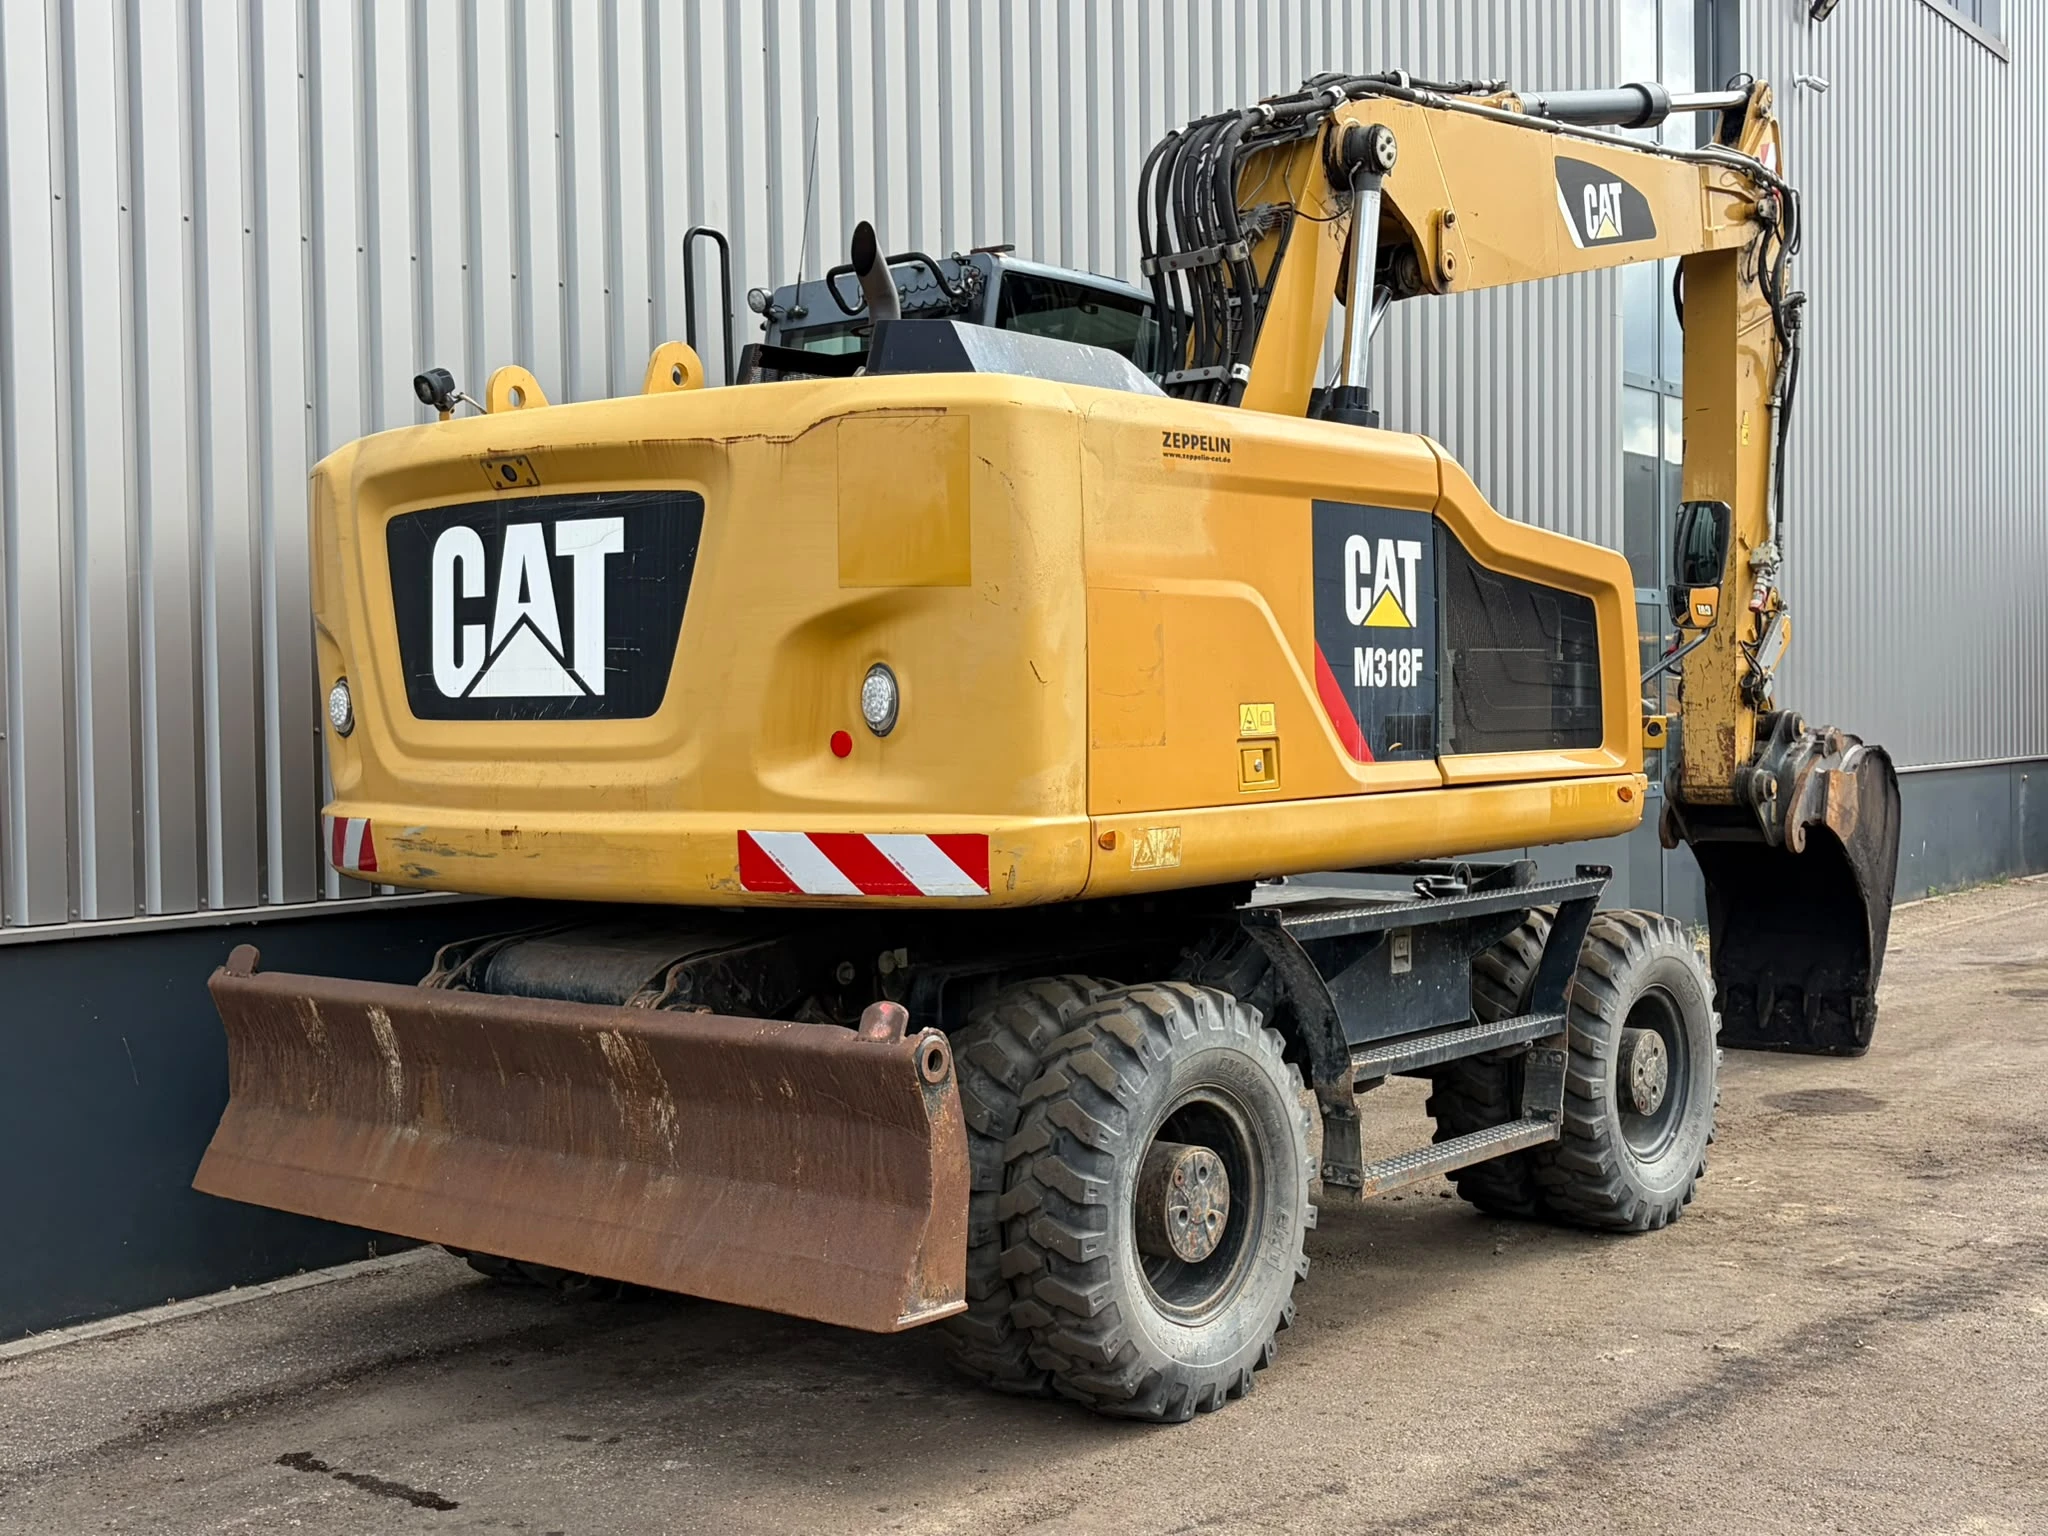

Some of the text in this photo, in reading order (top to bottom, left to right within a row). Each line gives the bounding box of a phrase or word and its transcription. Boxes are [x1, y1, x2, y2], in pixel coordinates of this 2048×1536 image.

[1583, 182, 1623, 240] CAT
[1162, 431, 1231, 453] ZEPPELIN
[1162, 451, 1231, 463] www.zeppelin-cat.de
[1344, 534, 1422, 628] CAT
[432, 516, 625, 698] CAT
[1353, 646, 1423, 688] M318F
